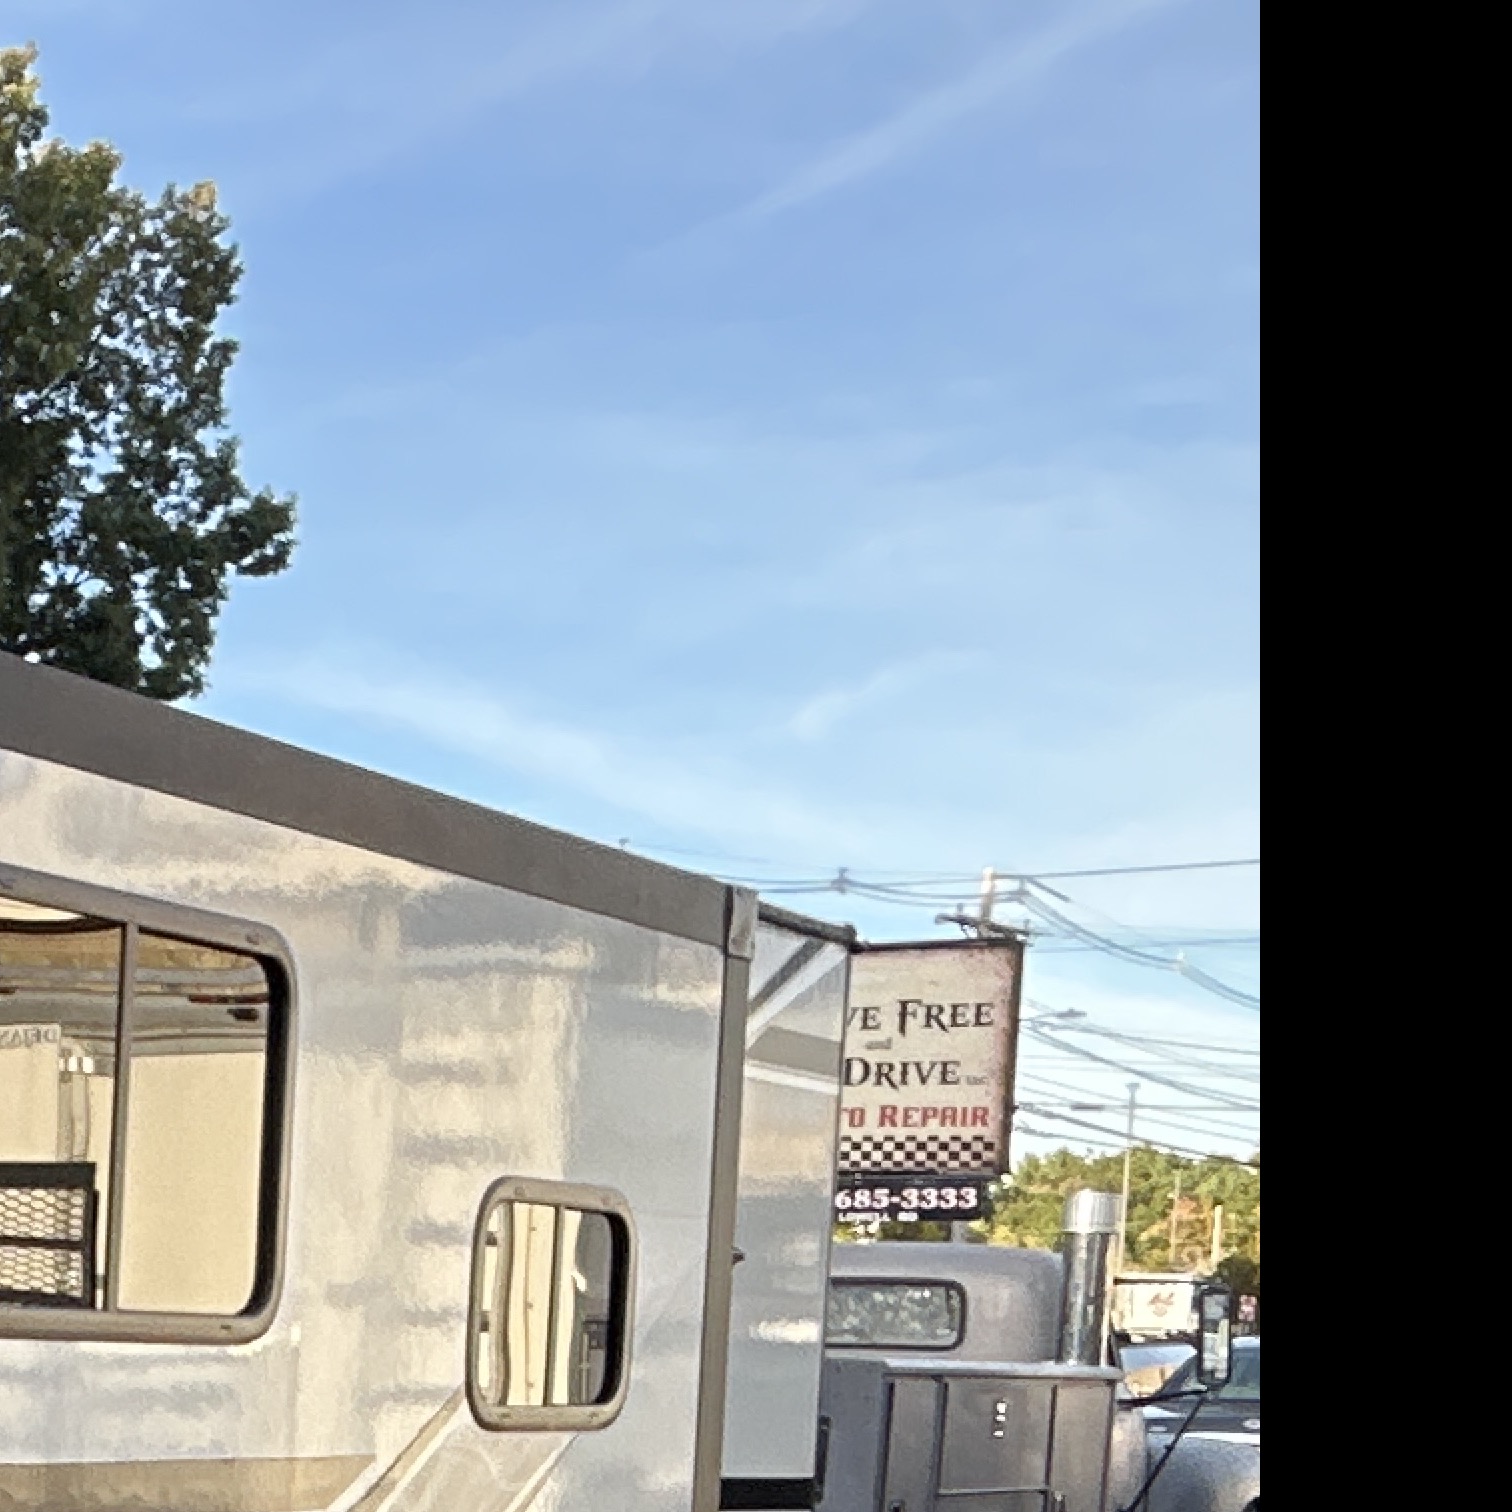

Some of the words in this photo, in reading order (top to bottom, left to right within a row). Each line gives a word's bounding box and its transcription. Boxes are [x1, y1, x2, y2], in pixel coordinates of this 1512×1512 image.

[897, 999, 995, 1037] FREE
[844, 1057, 961, 1092] DRIVE
[878, 1105, 990, 1128] REPAIR
[835, 1187, 977, 1210] 685-3333
